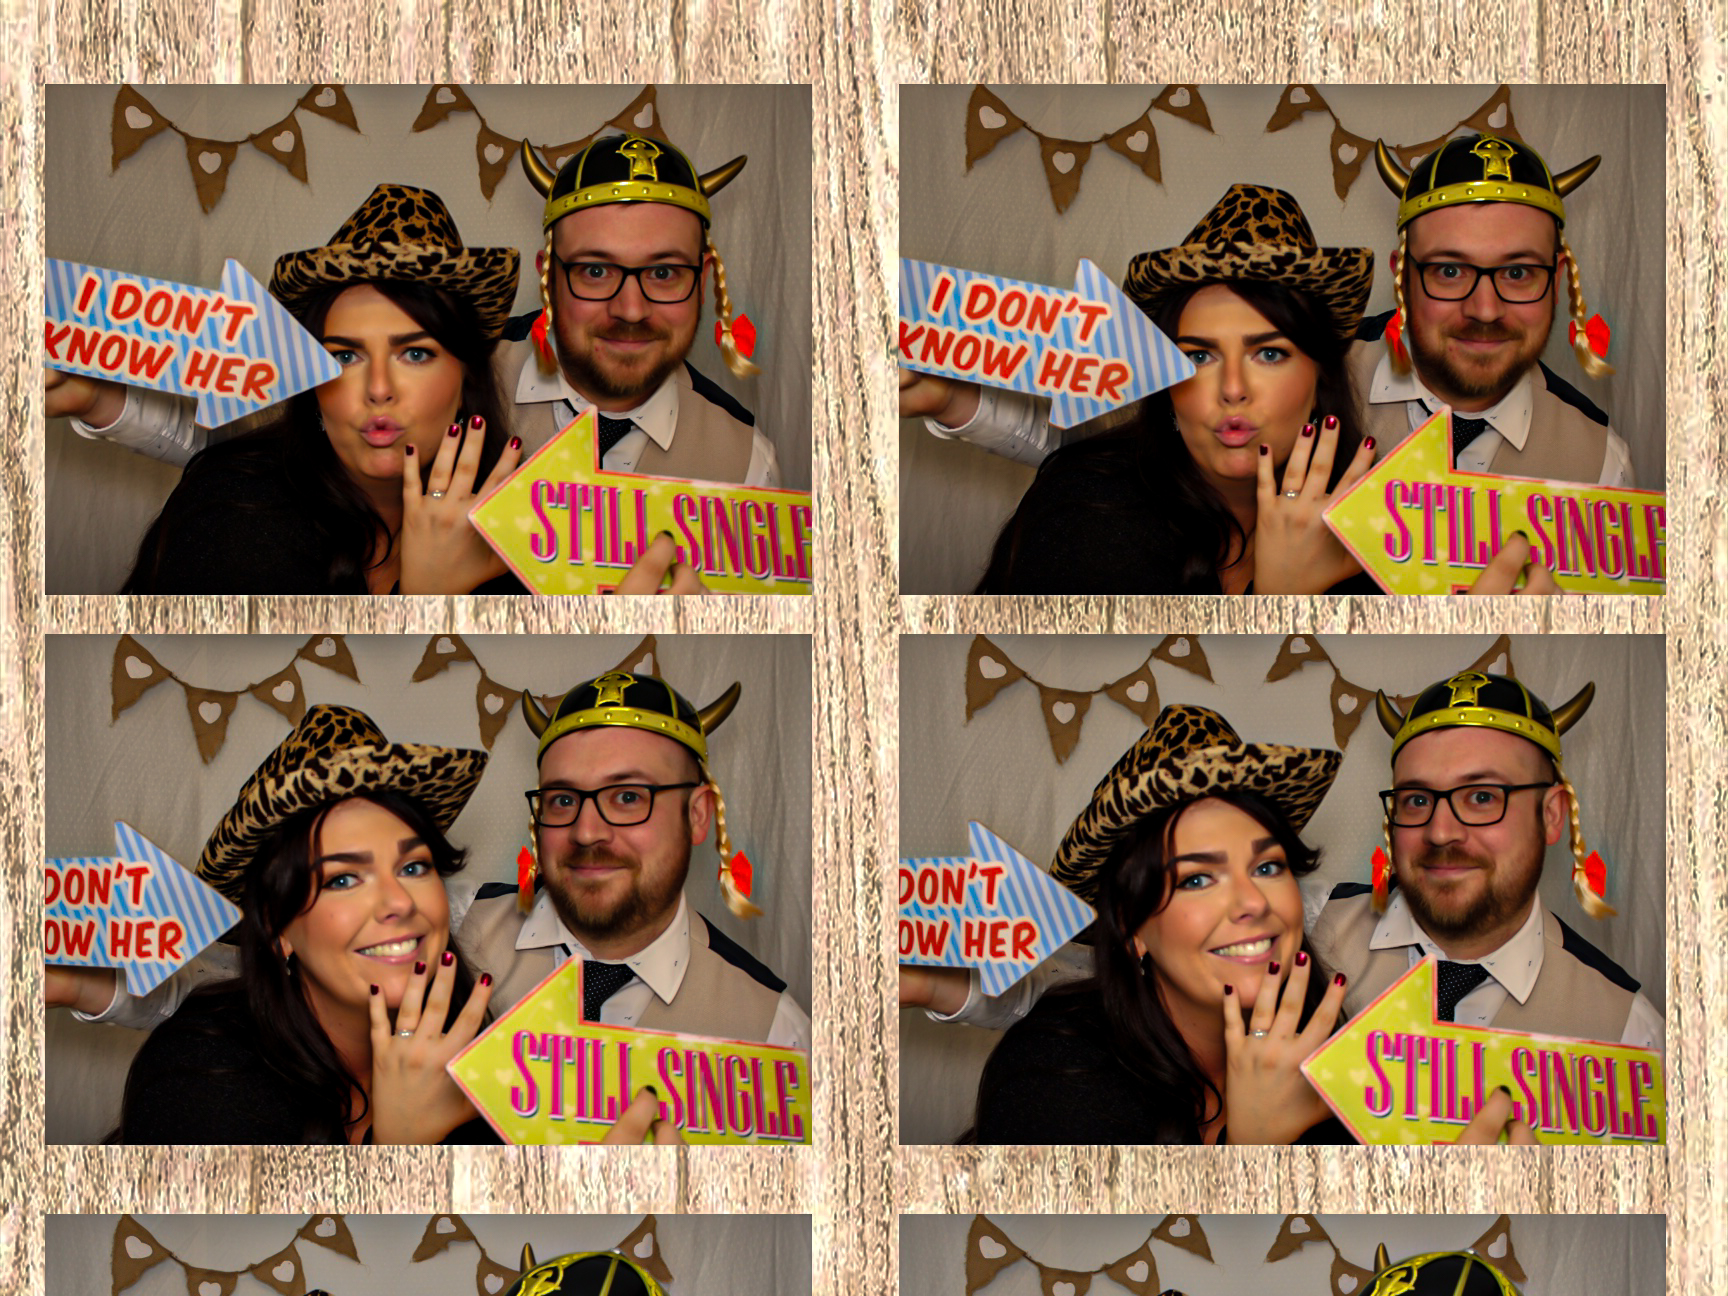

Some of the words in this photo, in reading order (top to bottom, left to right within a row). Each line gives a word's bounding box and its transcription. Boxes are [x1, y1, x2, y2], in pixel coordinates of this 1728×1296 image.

[77, 276, 98, 313] I
[110, 283, 255, 343] DON'T
[931, 276, 952, 313] I
[964, 283, 1109, 343] DON'T
[45, 320, 175, 380] KNOW
[183, 350, 276, 401] HER
[899, 320, 1029, 380] KNOW
[1037, 350, 1130, 401] HER
[529, 479, 649, 569] STILL
[672, 493, 812, 584] SINGLE
[1383, 479, 1503, 569] STILL
[1526, 493, 1666, 584] SINGLE
[45, 861, 150, 906] DON'T
[899, 861, 1004, 906] DON'T
[110, 920, 184, 960] HER
[964, 920, 1038, 960] HER
[510, 1030, 632, 1125] STILL
[656, 1047, 805, 1142] SINGLE
[1364, 1030, 1486, 1125] STILL
[1510, 1047, 1659, 1142] SINGLE
